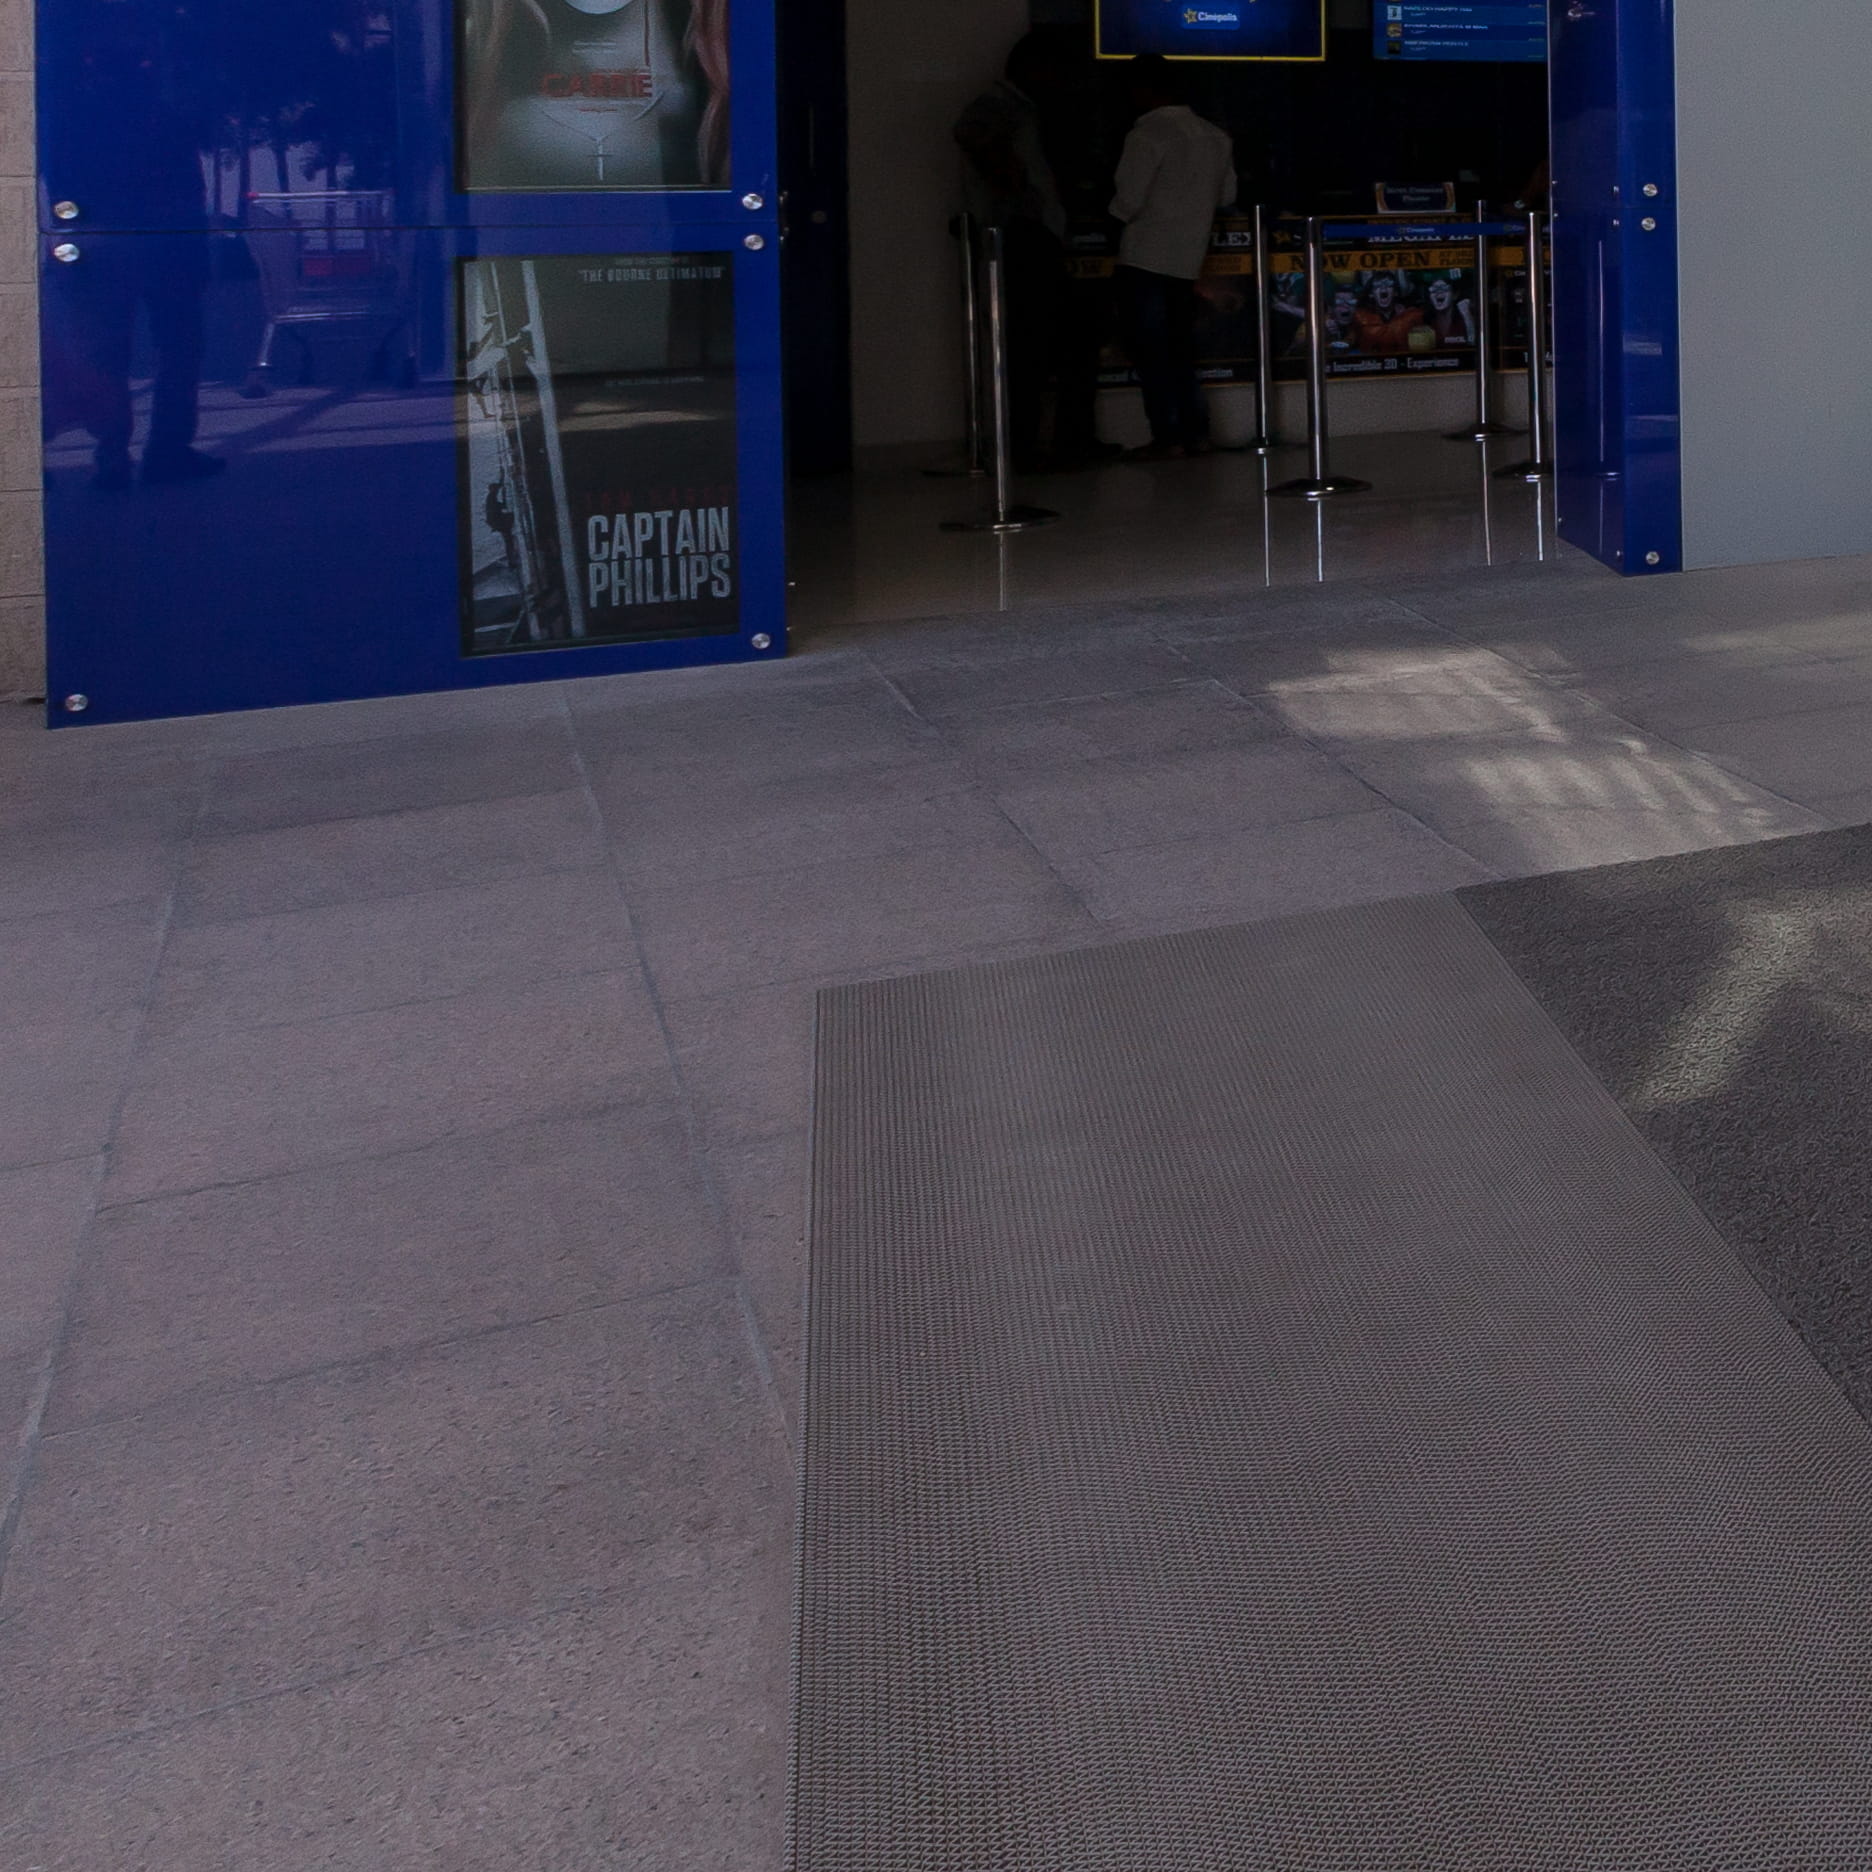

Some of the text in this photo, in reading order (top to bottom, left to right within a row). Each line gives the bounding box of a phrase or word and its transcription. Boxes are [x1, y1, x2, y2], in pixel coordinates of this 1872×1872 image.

[542, 71, 654, 99] CARRIE
[1290, 252, 1352, 271] NW
[1359, 250, 1432, 269] OPEN
[607, 267, 651, 283] BOURNE
[587, 505, 730, 562] CAPTAIN
[588, 551, 732, 608] PHILLIPS
